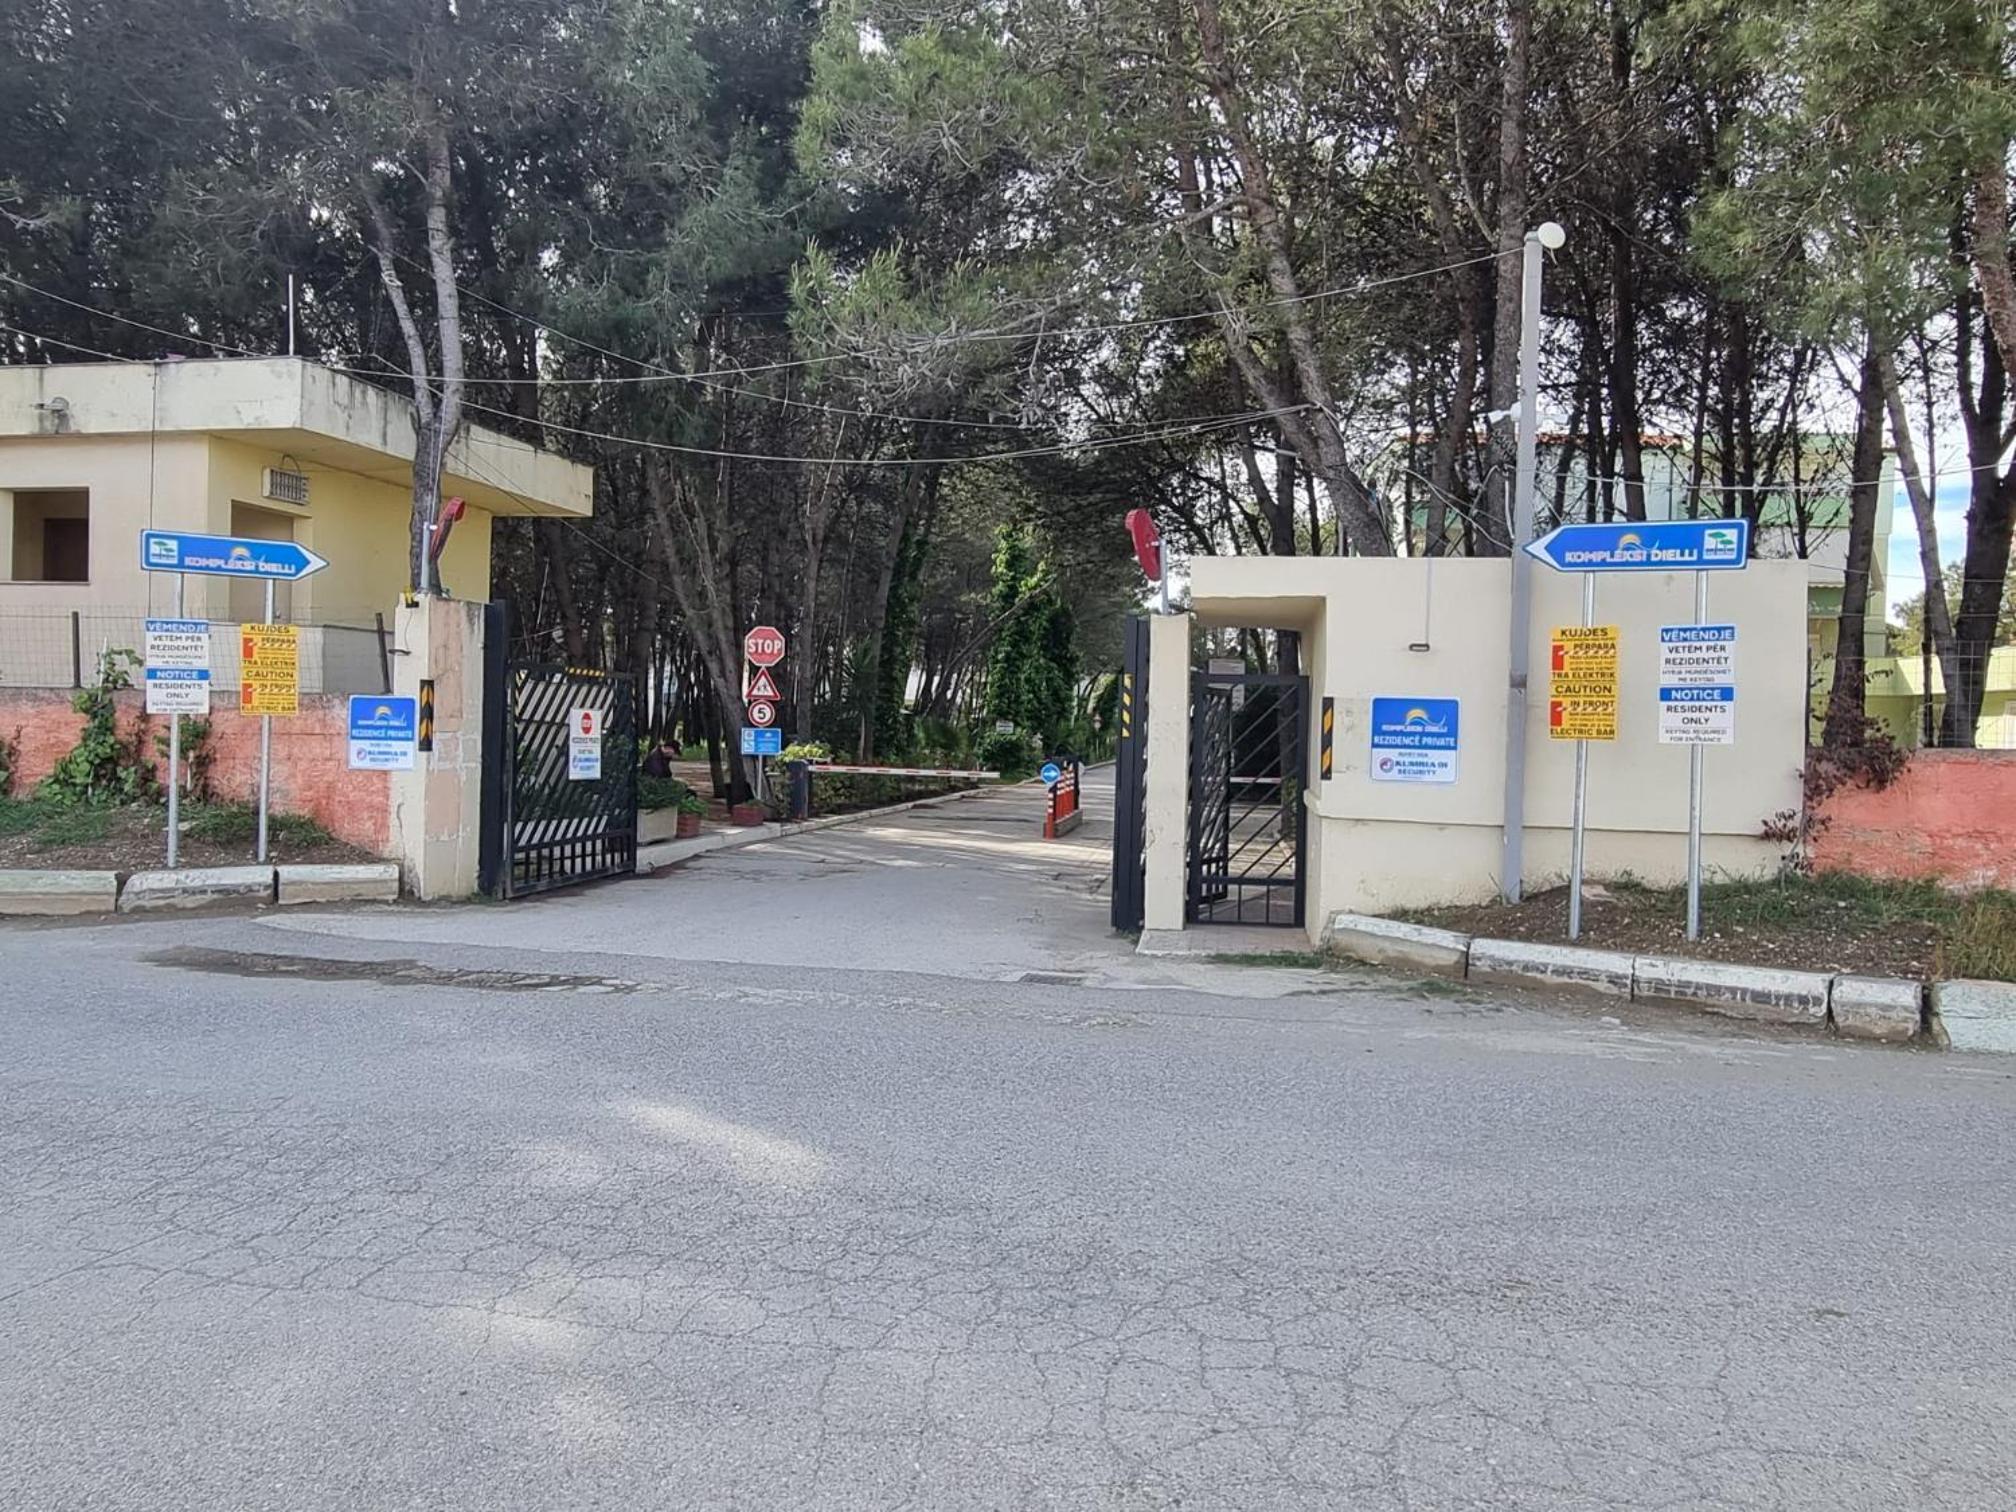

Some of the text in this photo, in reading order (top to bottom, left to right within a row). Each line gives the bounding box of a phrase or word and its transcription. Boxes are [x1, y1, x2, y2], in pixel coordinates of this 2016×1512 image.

[1564, 549, 1646, 563] KOMPLEKSI
[1650, 547, 1698, 562] DIELLI
[183, 556, 296, 574] KOMPLEKSI DIELLI
[249, 624, 290, 634] KUJDES
[1560, 628, 1609, 638] KUJDES
[748, 639, 782, 655] STOP
[156, 670, 198, 680] NOTICE
[246, 669, 295, 679] CAUTION
[1553, 671, 1616, 679] TRA ELEKTRIK
[152, 682, 203, 690] RESIDENTS
[1555, 684, 1612, 694] CAUTION
[1671, 689, 1721, 700] NOTICE
[1582, 700, 1615, 708] FRONT
[1666, 704, 1727, 713] RESIDENTS
[757, 707, 767, 720] 5
[1681, 716, 1710, 725] ONLY
[1550, 727, 1616, 736] ELECTRIC BAR
